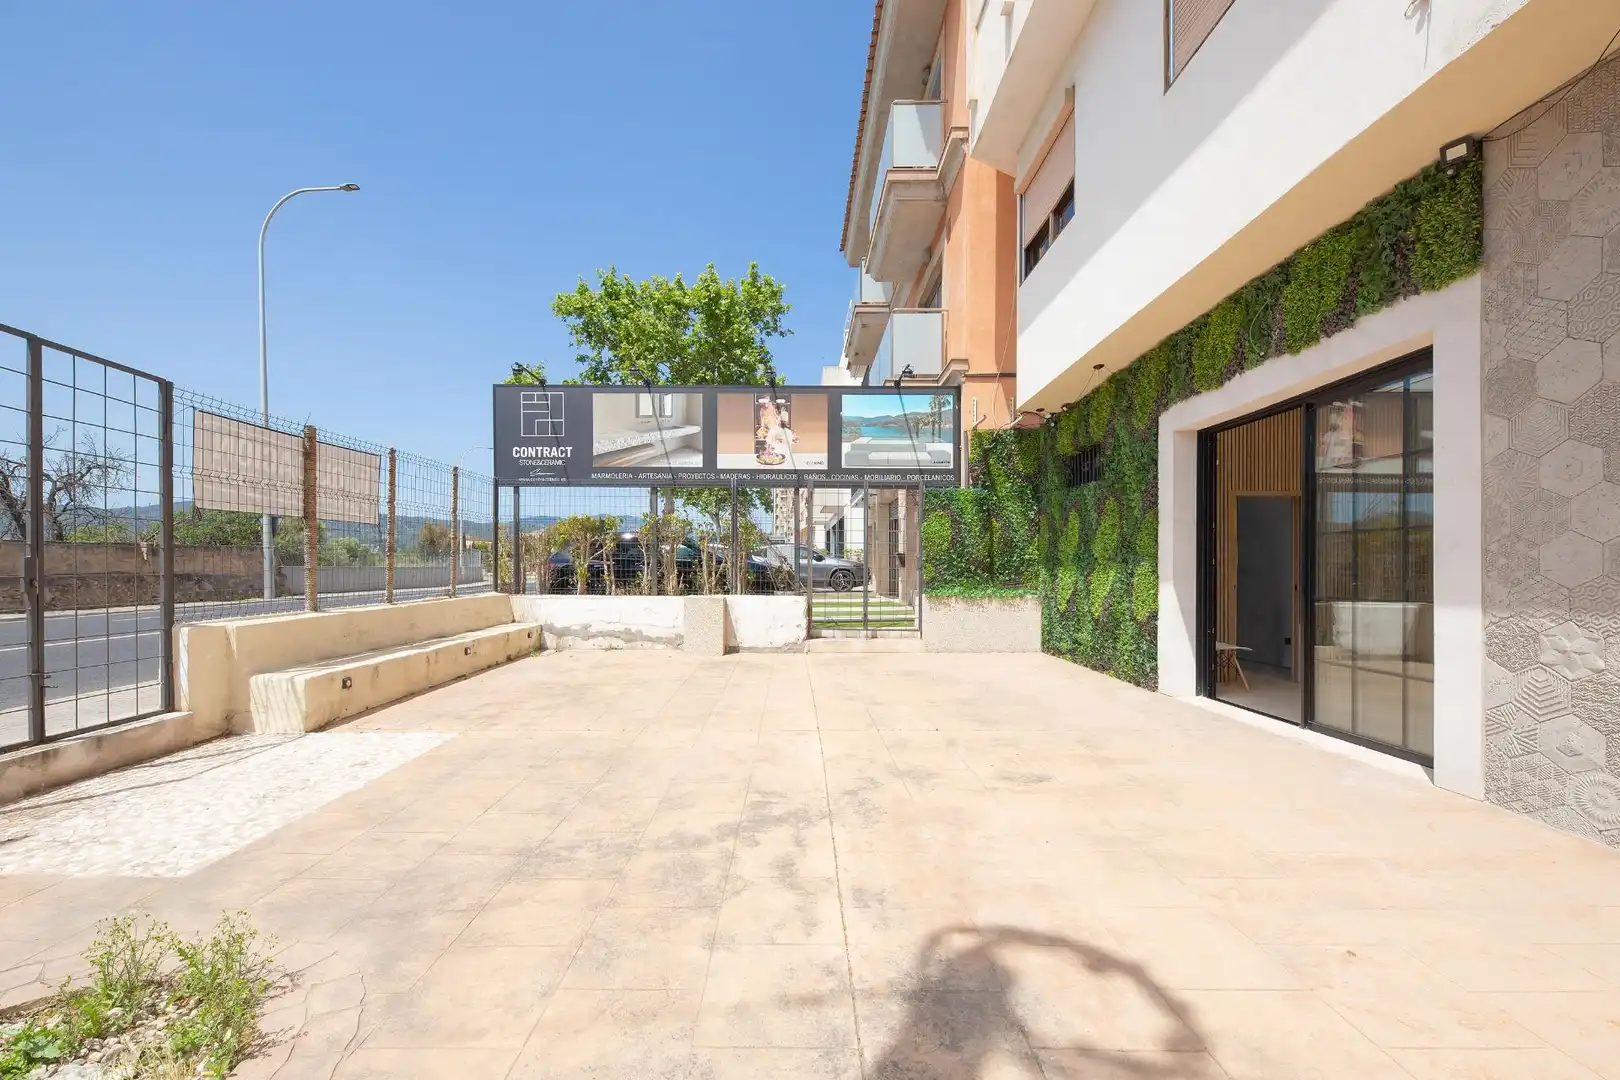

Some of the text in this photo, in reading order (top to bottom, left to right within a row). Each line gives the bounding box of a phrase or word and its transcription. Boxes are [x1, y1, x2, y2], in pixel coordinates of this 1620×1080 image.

[512, 446, 573, 458] CONTRACT
[591, 472, 633, 480] MARMOLERIA
[638, 472, 673, 480] ARTESANIA
[804, 472, 826, 480] BAÑOS
